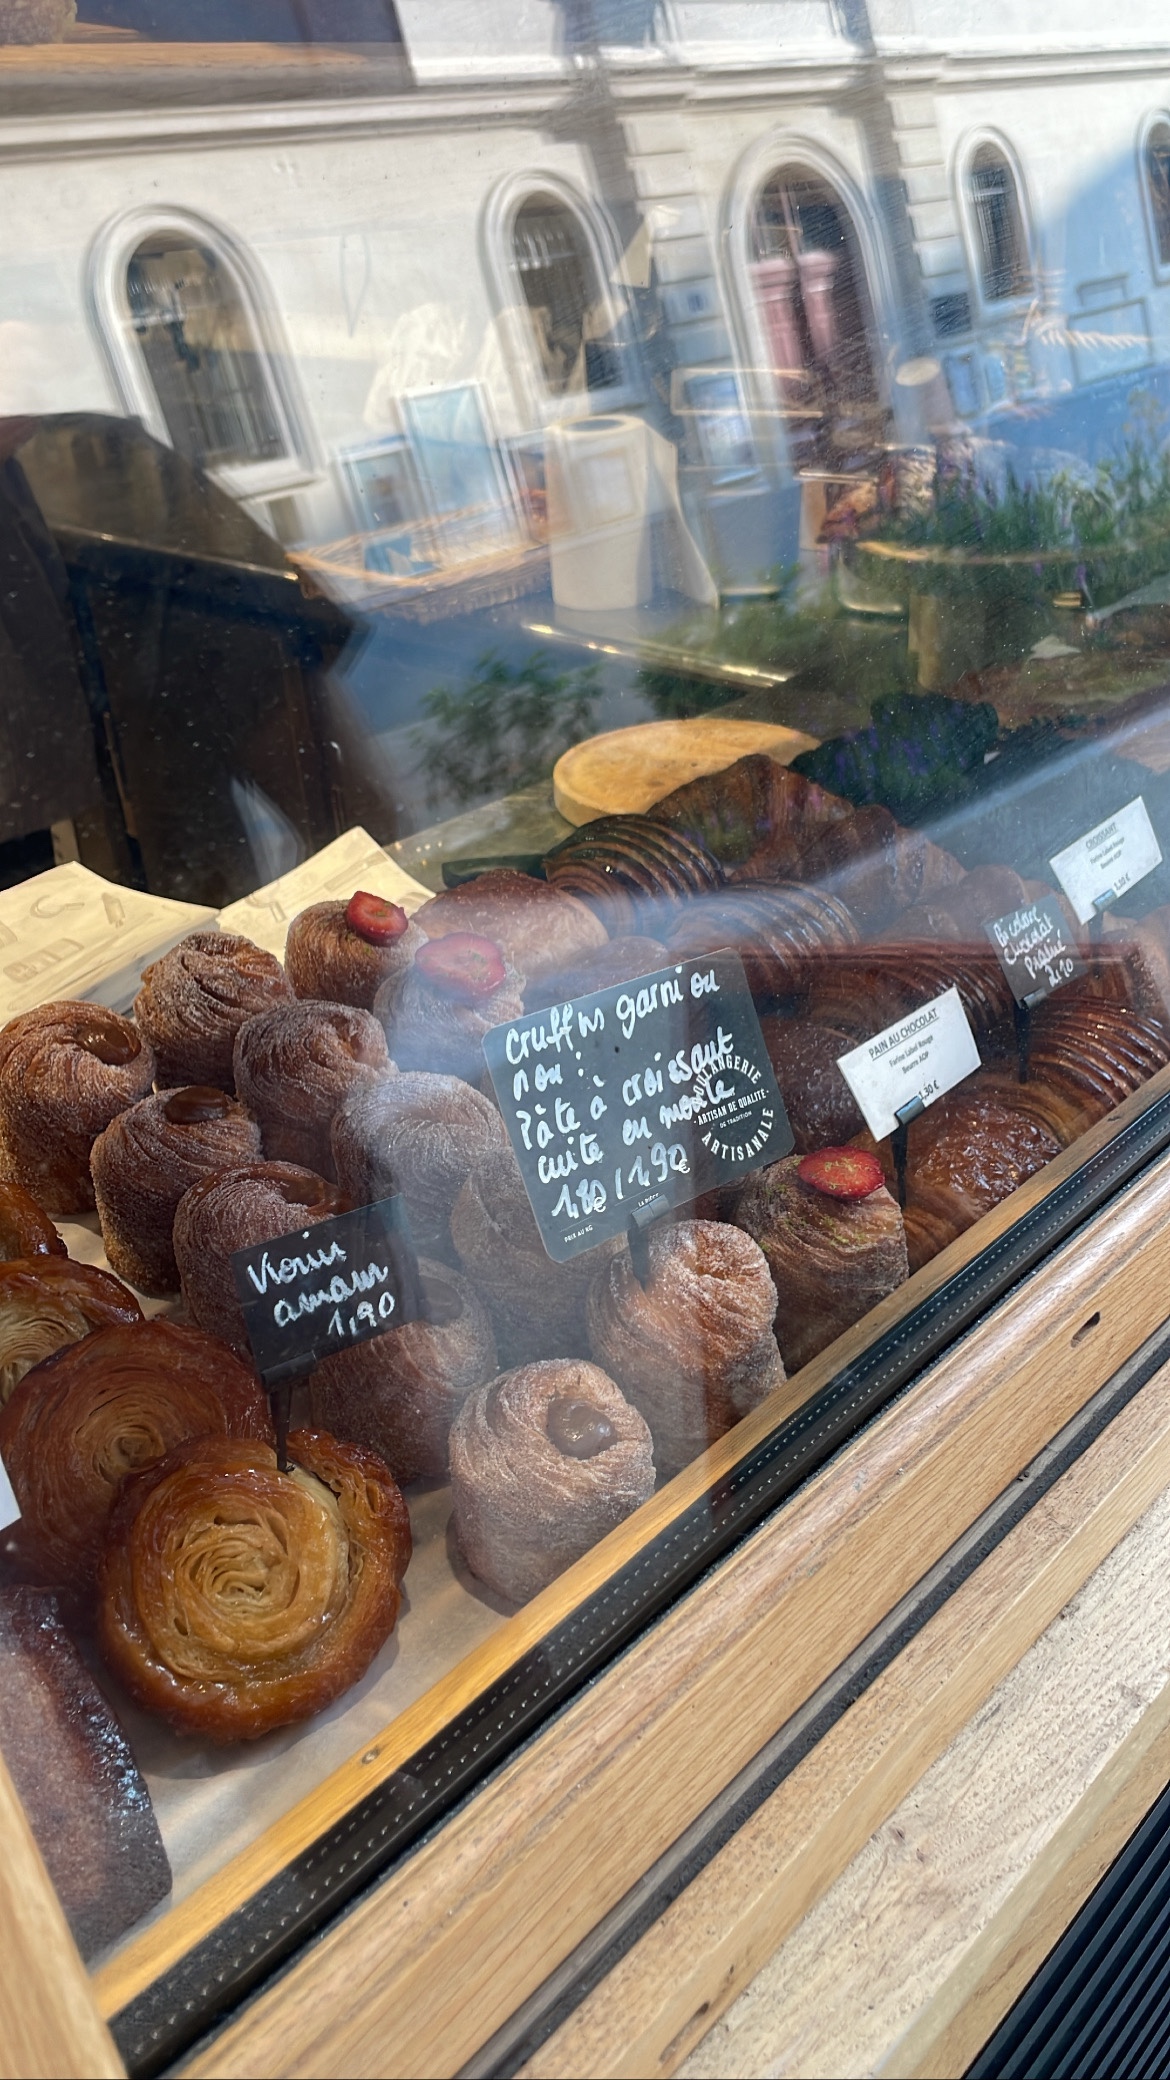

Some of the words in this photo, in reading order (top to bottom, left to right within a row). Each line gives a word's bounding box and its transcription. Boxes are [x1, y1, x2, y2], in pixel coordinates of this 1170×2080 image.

[616, 966, 684, 1039] garni
[690, 970, 720, 998] ou
[868, 1038, 889, 1059] PAIN
[889, 1032, 901, 1047] AU
[900, 1007, 938, 1038] CHOCOLAT
[516, 1097, 581, 1150] Pâte
[590, 1075, 608, 1119] à
[622, 1026, 734, 1106] croissant
[918, 1083, 934, 1100] 1,30
[697, 1104, 728, 1125] ARTISAN
[727, 1101, 738, 1113] DE
[701, 1107, 774, 1162] ARTISANALE
[719, 1120, 727, 1129] DE
[727, 1110, 753, 1125] TRADITION
[537, 1133, 604, 1183] cuite
[622, 1116, 652, 1146] en
[577, 1229, 586, 1238] AU
[585, 1224, 594, 1233] KG
[327, 1291, 396, 1337] 1,90
